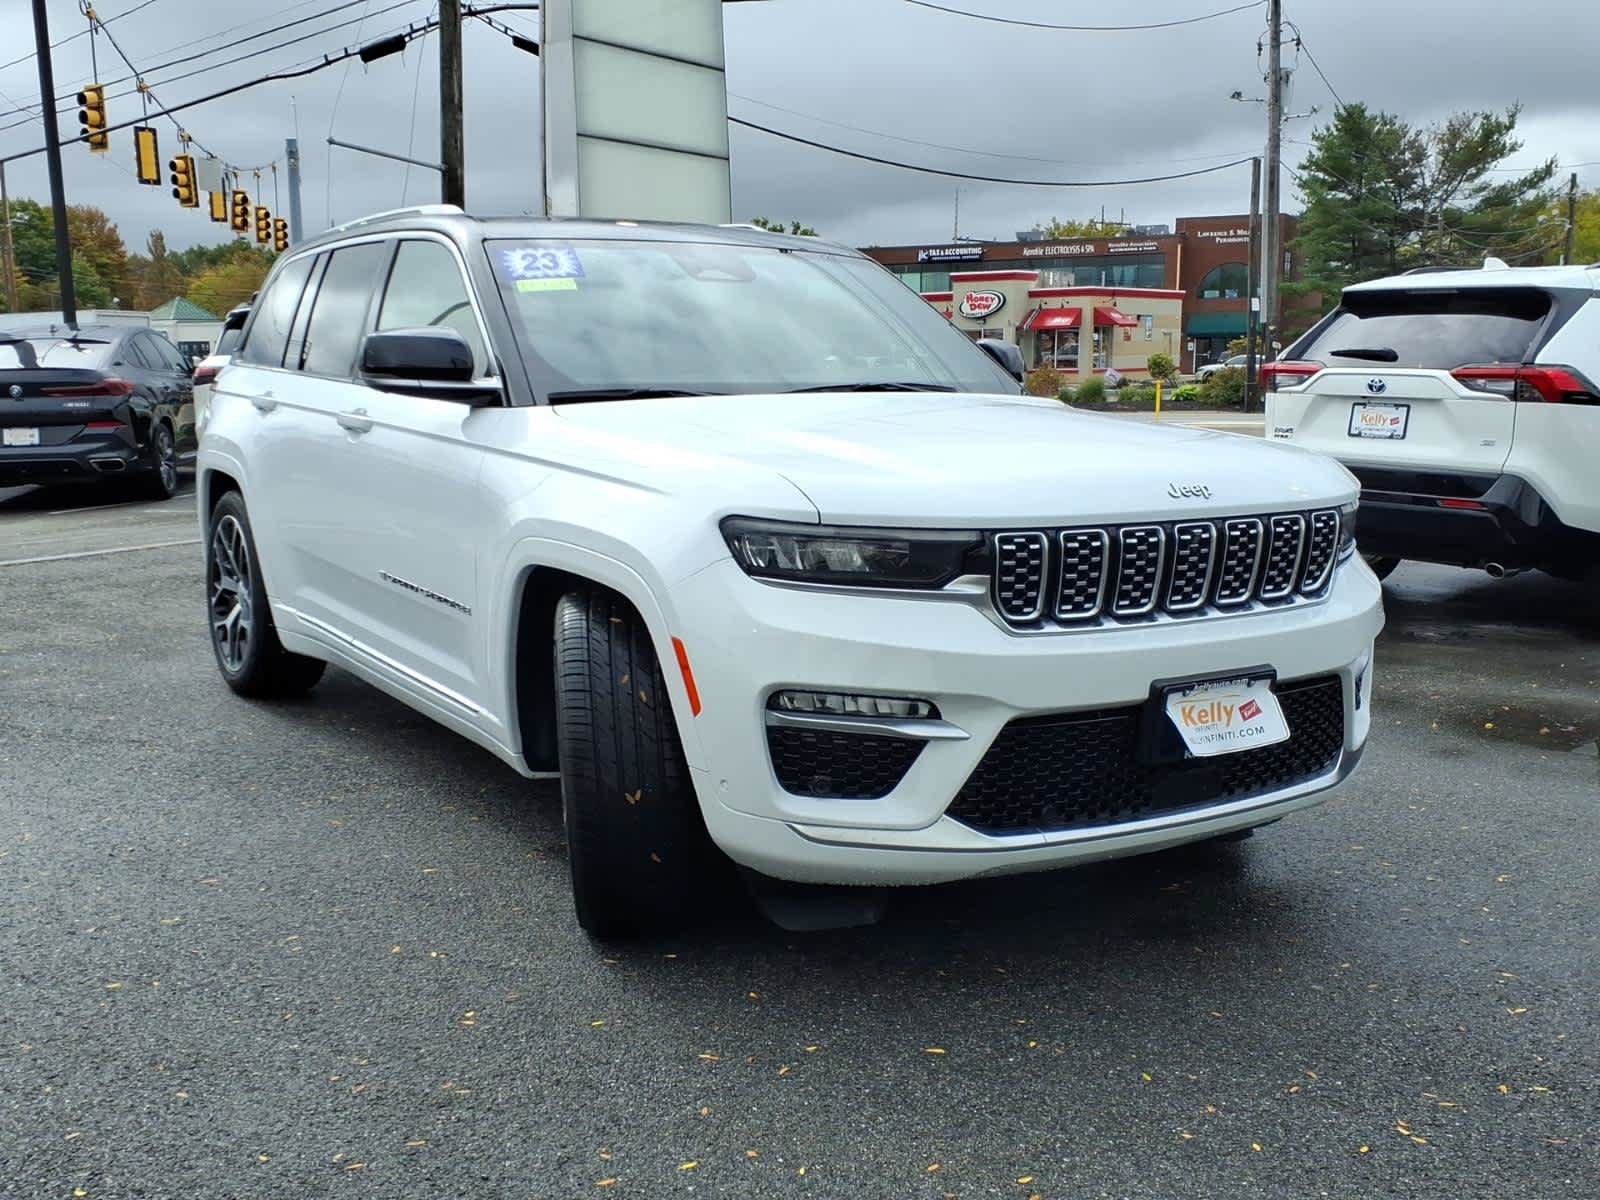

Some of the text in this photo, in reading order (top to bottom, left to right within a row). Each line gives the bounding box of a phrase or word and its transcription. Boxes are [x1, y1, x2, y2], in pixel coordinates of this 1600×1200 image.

[945, 247, 982, 255] ACCOUNTING
[520, 253, 560, 271] 23
[1361, 414, 1388, 425] Kelly
[1167, 483, 1212, 500] Jeep
[1180, 702, 1234, 727] Kelly
